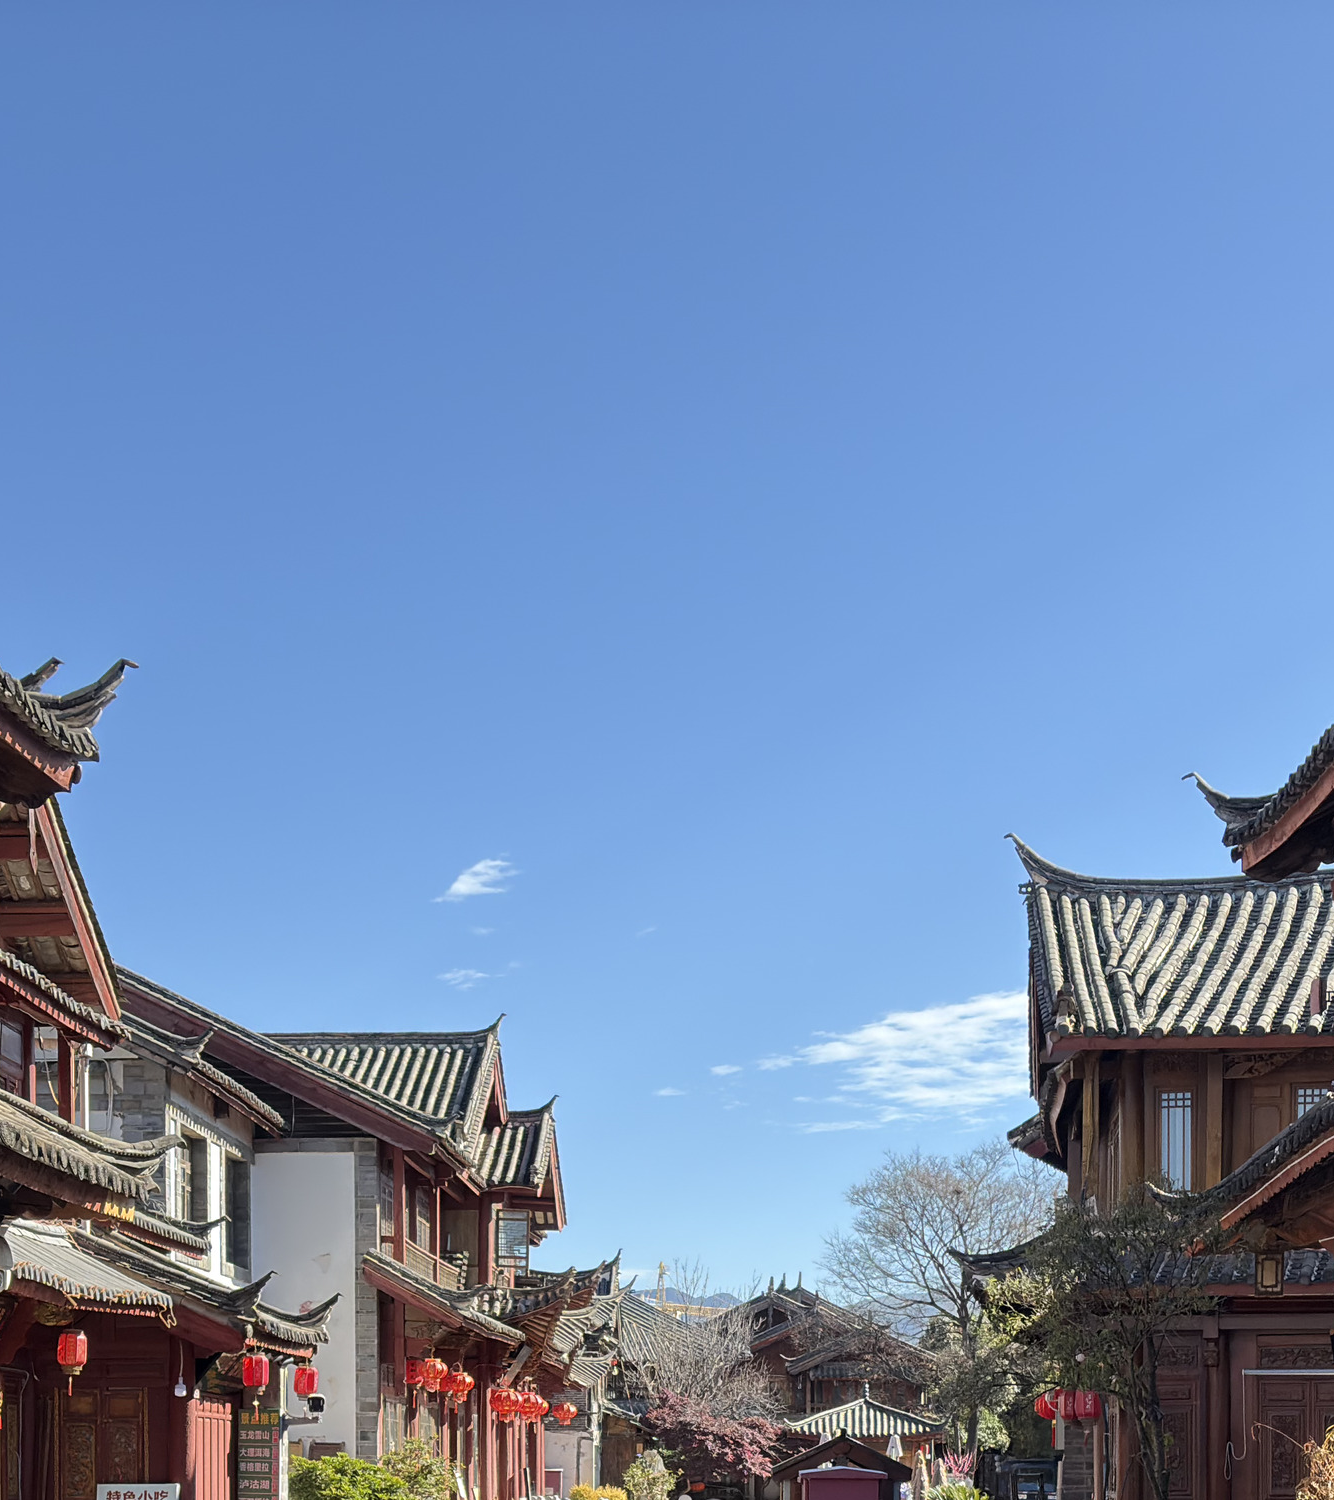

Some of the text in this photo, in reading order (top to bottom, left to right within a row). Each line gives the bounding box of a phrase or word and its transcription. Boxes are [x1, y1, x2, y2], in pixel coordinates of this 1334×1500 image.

[241, 1412, 280, 1425] 景点推荐
[239, 1430, 270, 1440] 玉龙雪山
[239, 1448, 271, 1457] 大理洱海
[239, 1462, 269, 1472] 香格里拉
[239, 1479, 270, 1489] 泸沽湖
